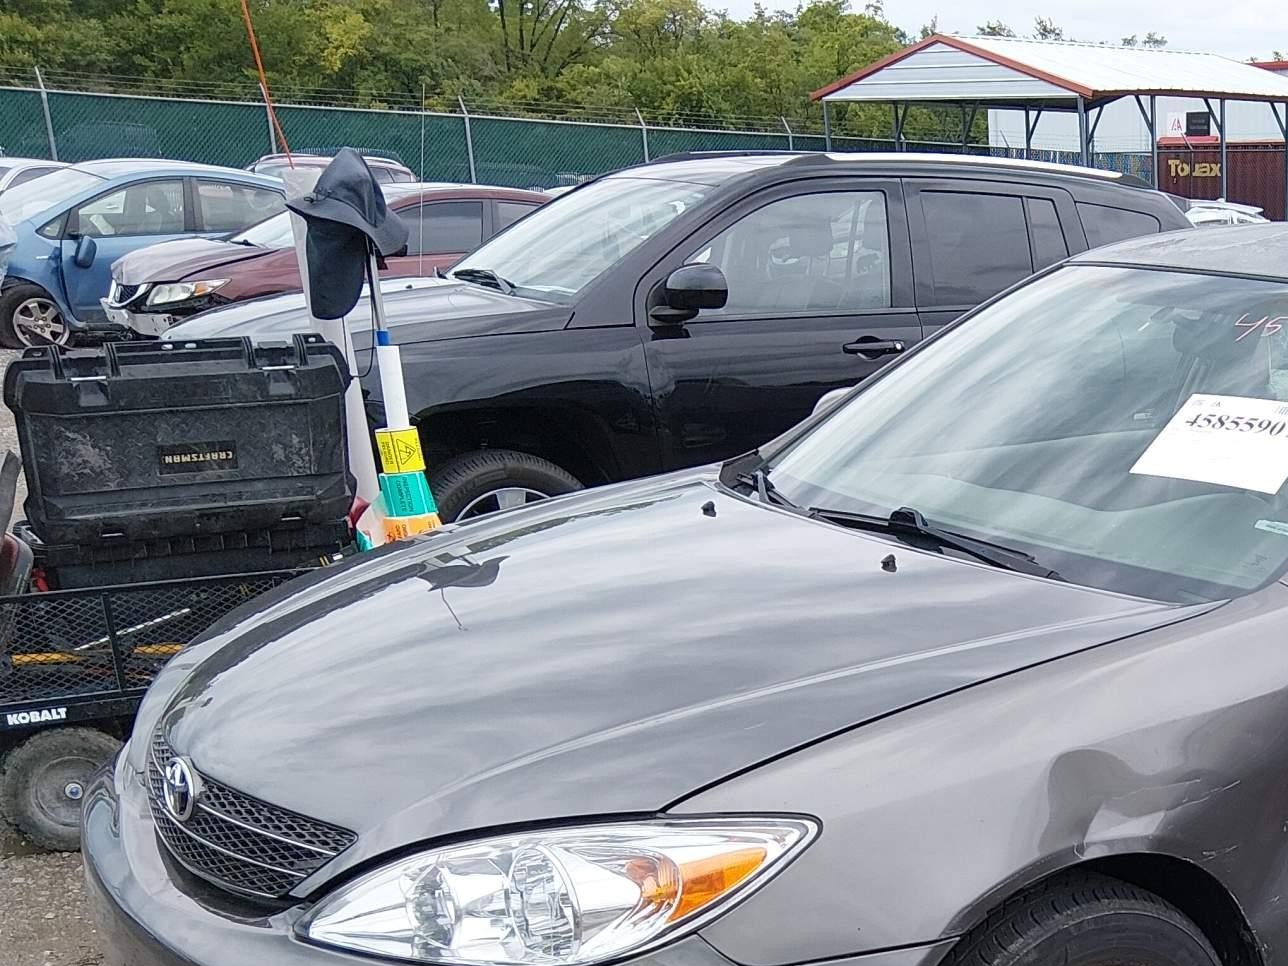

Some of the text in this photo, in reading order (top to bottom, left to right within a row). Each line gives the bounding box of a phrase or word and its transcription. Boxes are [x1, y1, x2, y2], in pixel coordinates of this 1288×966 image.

[164, 451, 233, 464] CRAFTSMAN
[396, 480, 407, 512] COMPLETE
[402, 477, 414, 513] INSPECTION
[7, 707, 68, 726] KOBALT
